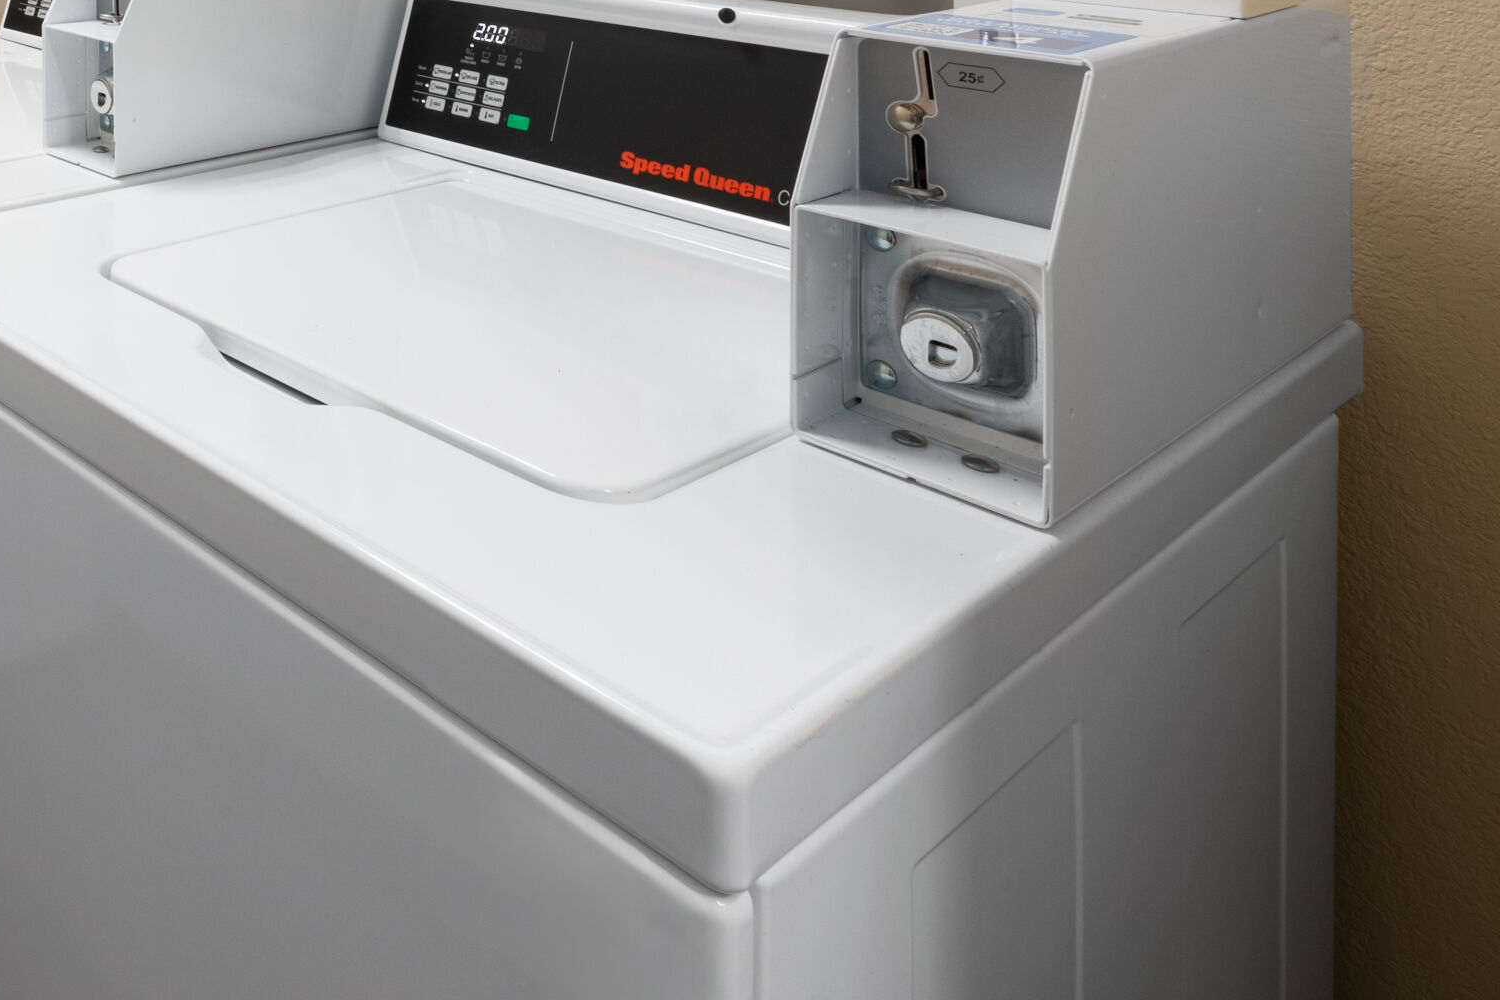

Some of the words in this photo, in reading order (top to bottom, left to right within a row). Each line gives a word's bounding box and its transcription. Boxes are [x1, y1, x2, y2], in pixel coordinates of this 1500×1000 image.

[473, 22, 509, 44] 2.00
[958, 71, 985, 85] 25¢
[619, 151, 691, 183] Speed
[693, 167, 771, 203] Queen
